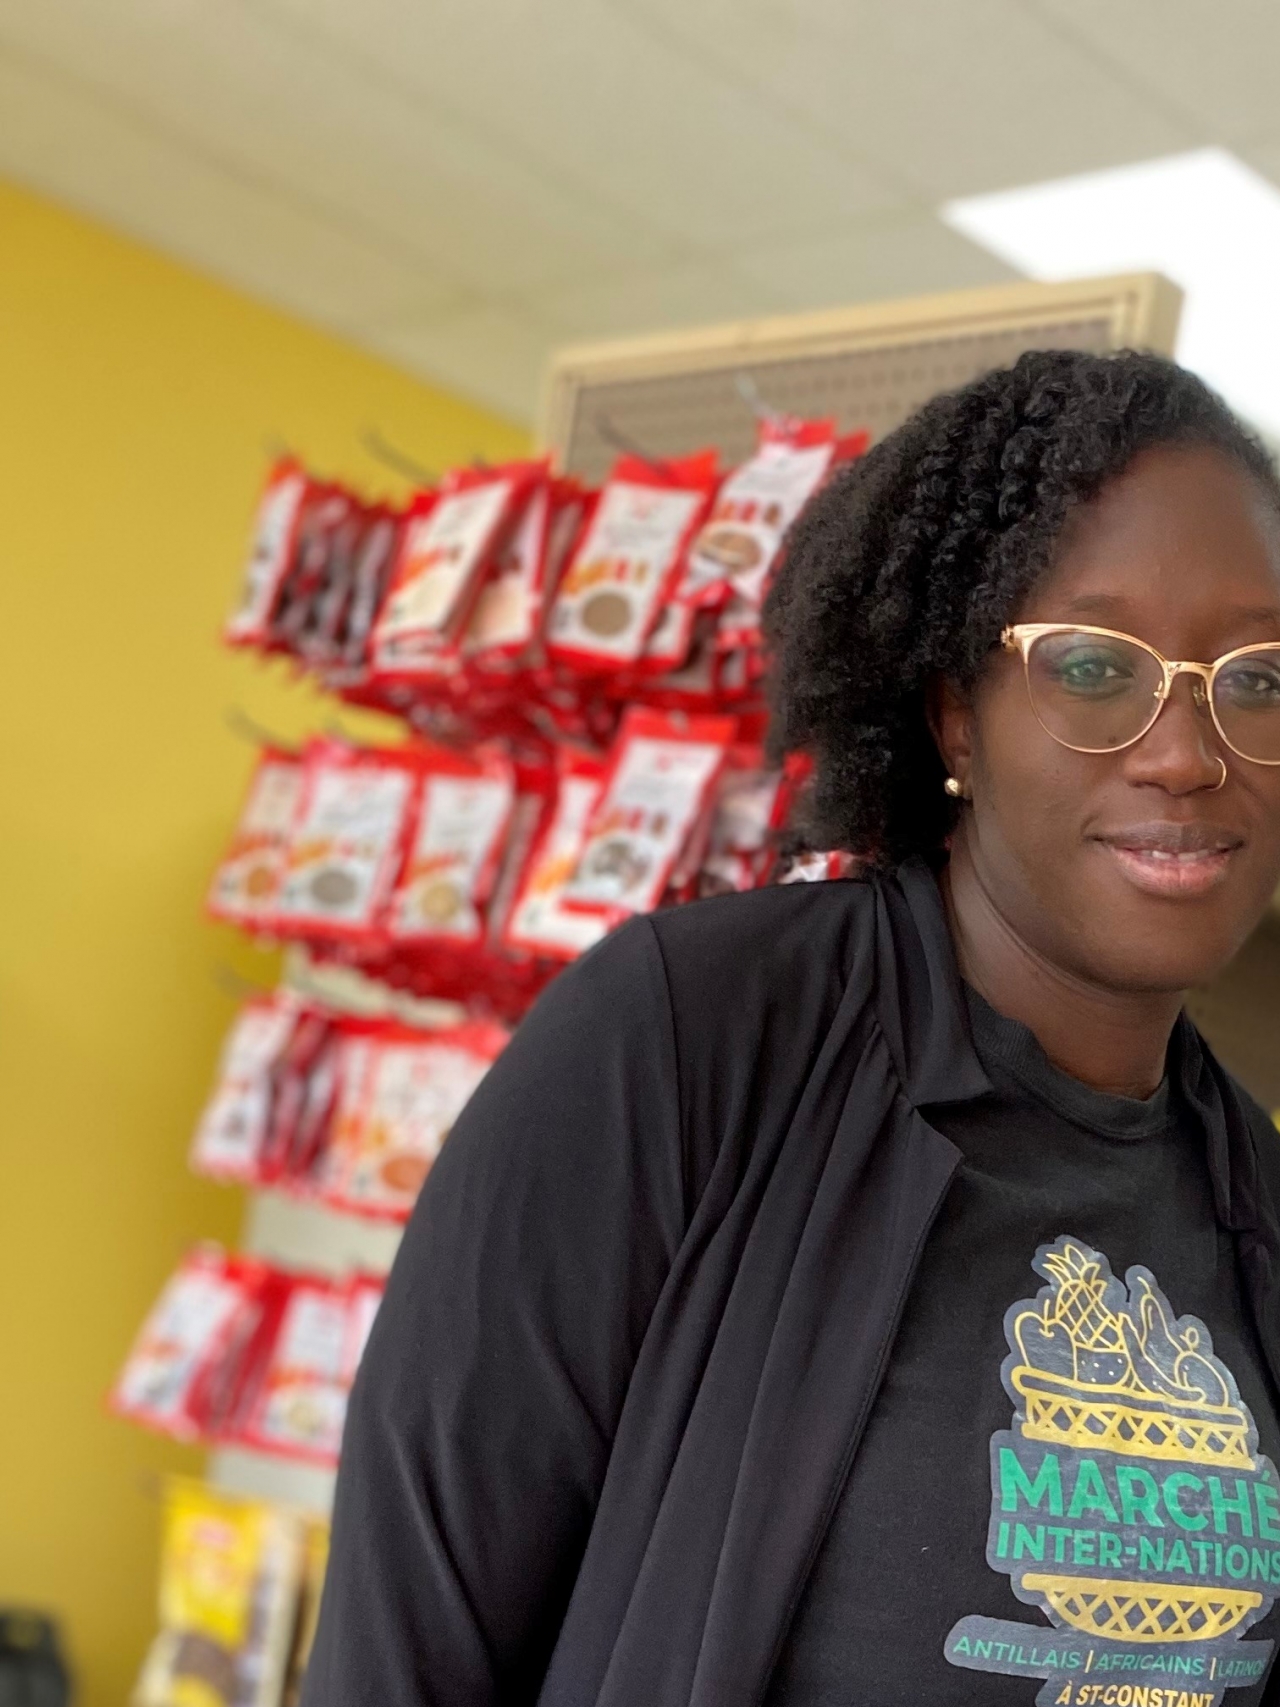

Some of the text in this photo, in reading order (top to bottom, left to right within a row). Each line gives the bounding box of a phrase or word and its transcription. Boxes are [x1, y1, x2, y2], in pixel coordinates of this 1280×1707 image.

[953, 1636, 1080, 1669] ANTILLAIS
[1094, 1653, 1205, 1675] AFRICAINS
[1055, 1680, 1072, 1705] À
